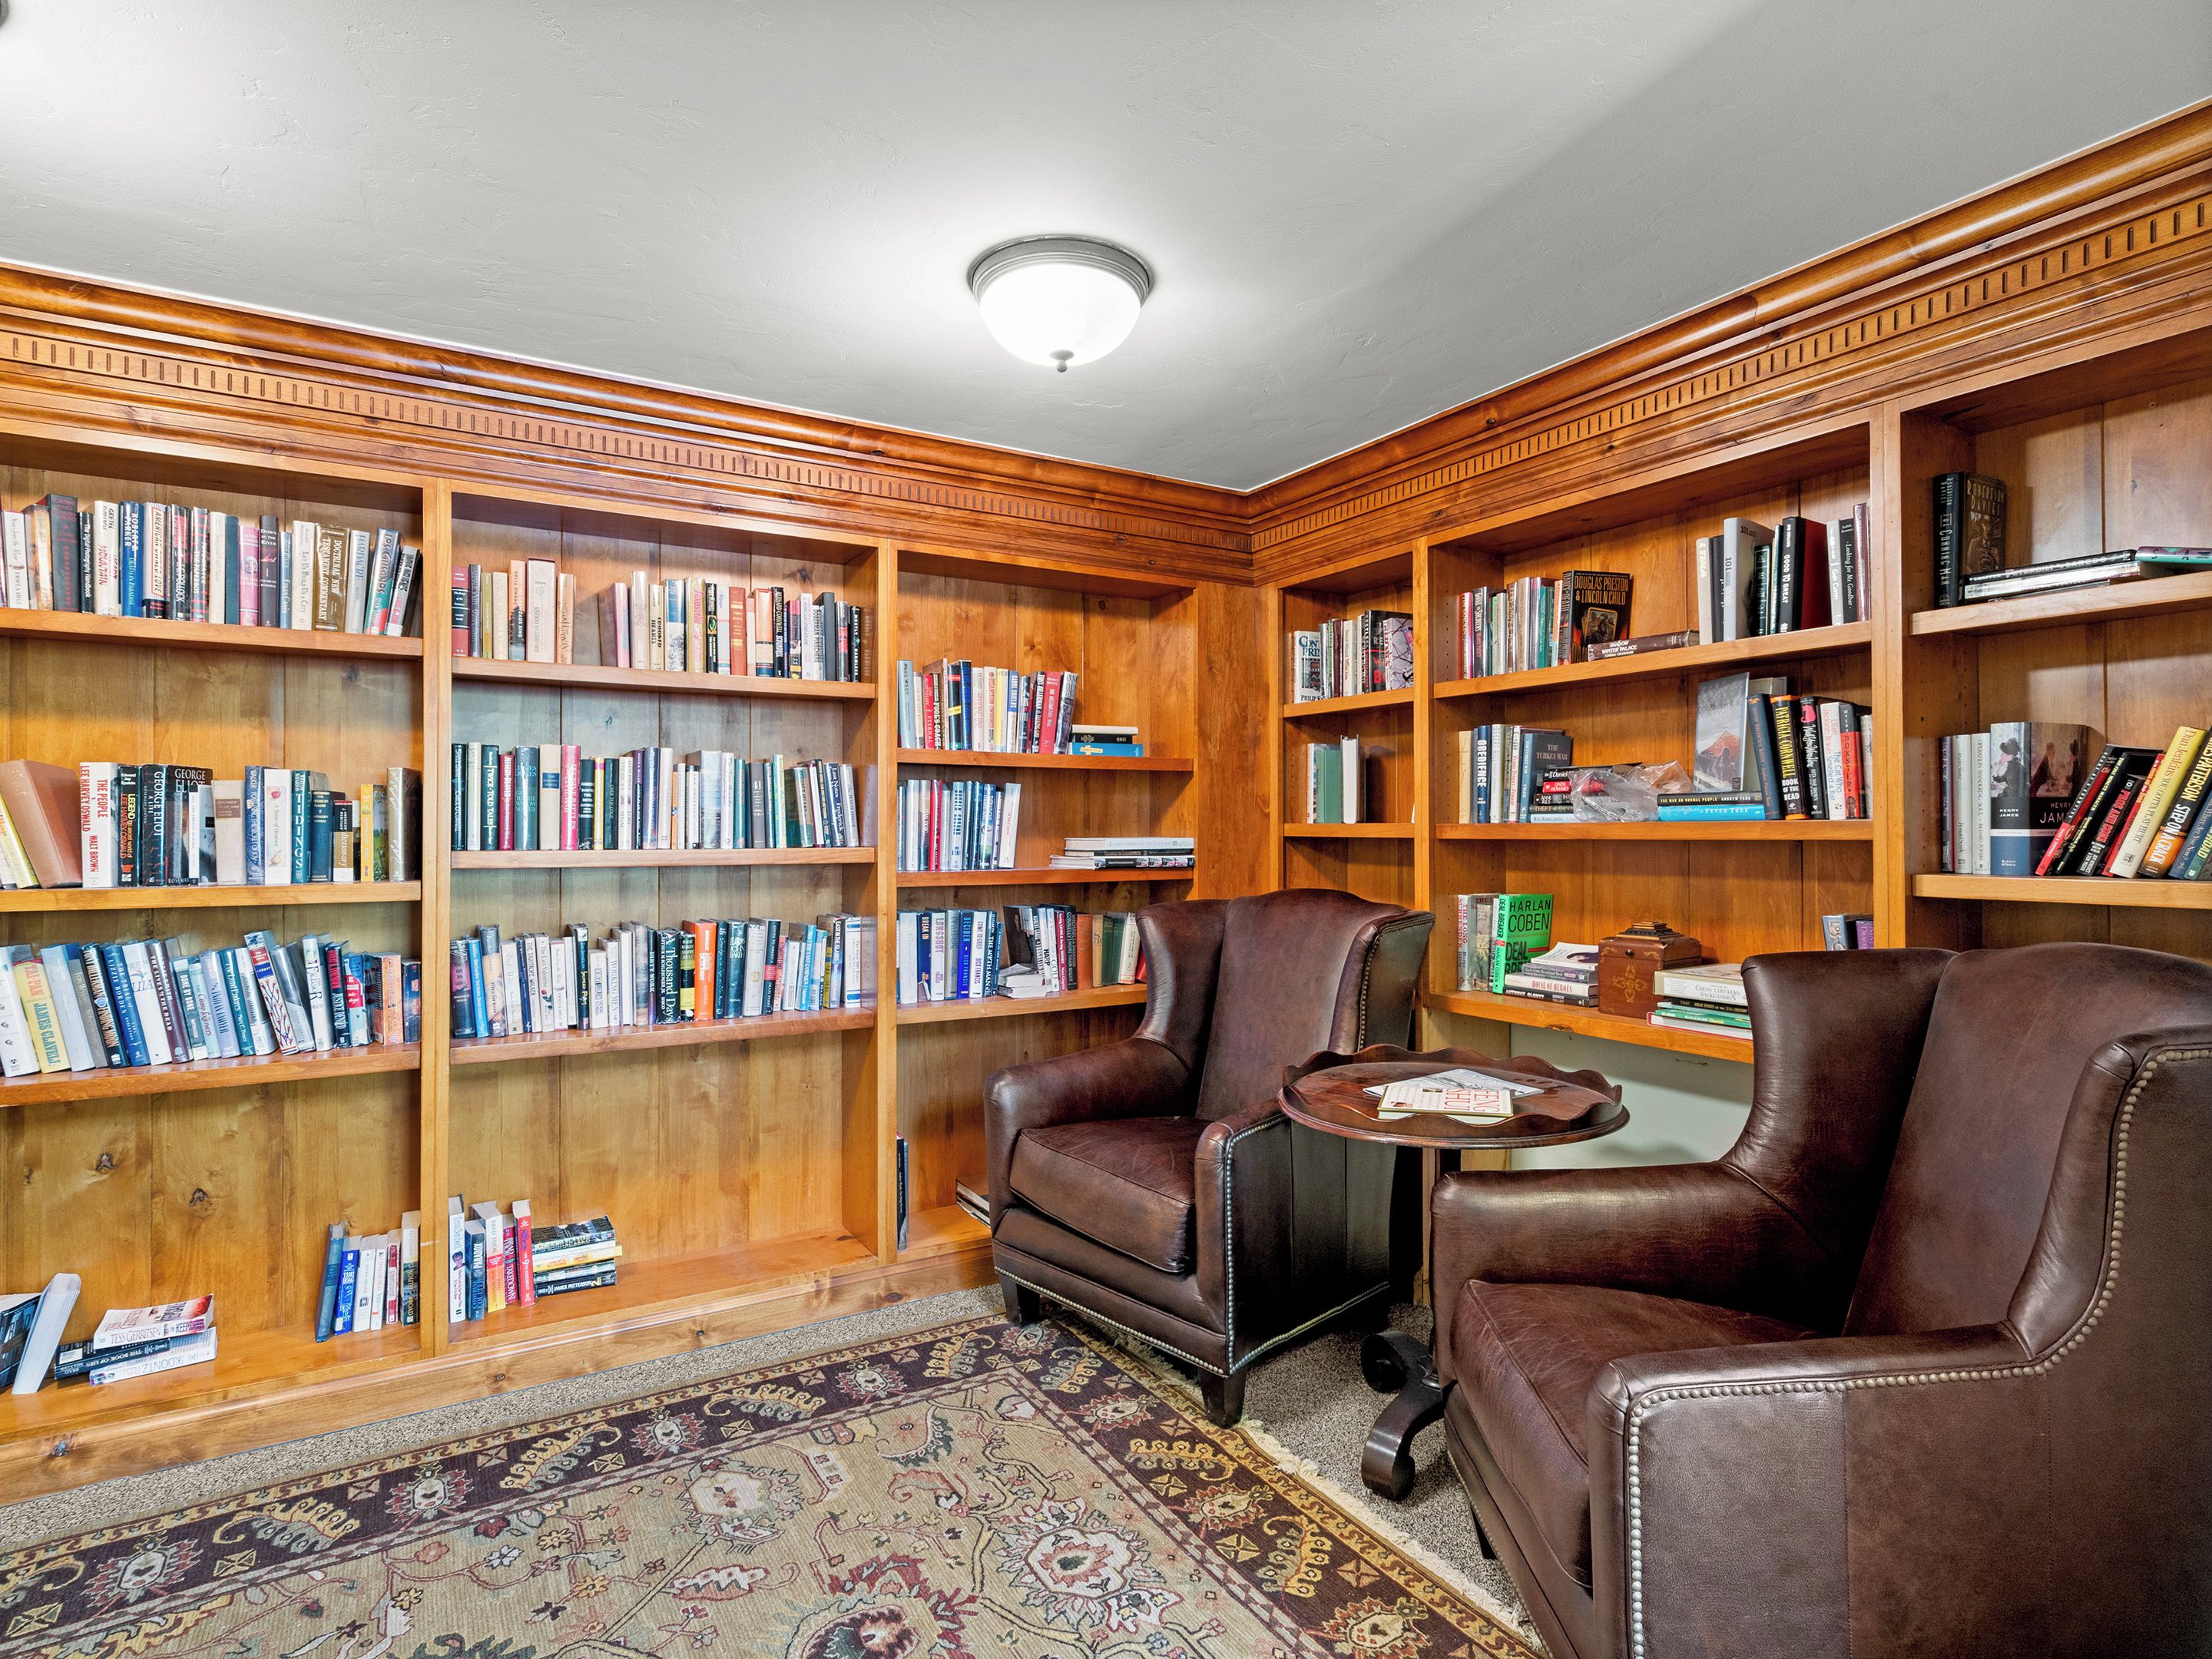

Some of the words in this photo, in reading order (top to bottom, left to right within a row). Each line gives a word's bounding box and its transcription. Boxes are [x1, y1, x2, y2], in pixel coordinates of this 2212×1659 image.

[1967, 479, 2005, 504] ROBERTSON
[1971, 497, 2001, 516] DAVIES
[384, 534, 392, 548] LOS
[1940, 529, 1952, 565] CUNNING
[98, 545, 108, 586] MOUNTAIN
[322, 537, 331, 575] TESTAMENT
[332, 540, 342, 575] DOCTRINAL
[1844, 544, 1853, 565] Looking
[331, 579, 339, 594] NEW
[1574, 576, 1603, 591] DOUGLAS
[1603, 577, 1628, 592] PRESTON
[1783, 574, 1791, 582] TO
[1940, 565, 1951, 585] MAN
[319, 577, 329, 620] COMMENTARY
[694, 590, 704, 624] Texasville
[1575, 591, 1581, 601] &
[1581, 590, 1608, 604] LINCOLN
[1608, 591, 1625, 605] CHILD
[1776, 707, 1789, 738] PATRICIA
[2184, 730, 2197, 745] Dan
[1477, 740, 1487, 787] OBEDIENCE
[1780, 740, 1796, 778] CORNWELL
[2169, 745, 2187, 777] Jenkins
[81, 766, 90, 777] LEE
[175, 768, 205, 780] GEORGE
[1553, 770, 1568, 778] Daniel
[2181, 758, 2211, 801] PATTERSON
[81, 779, 90, 804] HARVEY
[98, 780, 108, 792] THE
[154, 771, 164, 809] GEORGE
[98, 793, 108, 818] PEOPLE
[2170, 803, 2190, 823] STEP
[82, 806, 91, 832] OSWALD
[154, 812, 164, 836] ELIOT
[2164, 820, 2182, 836] ON
[90, 835, 98, 849] WALT
[2134, 823, 2149, 843] HURT
[90, 851, 98, 872] BROWN
[338, 833, 349, 867] dictionary
[2149, 840, 2172, 866] CRACK
[1510, 899, 1551, 912] HARLAN
[1496, 912, 1505, 938] BREAKER
[1508, 912, 1550, 933] COBEN
[666, 936, 673, 945] A
[935, 918, 944, 953] LONGSHOT
[1505, 940, 1528, 962] DEAL
[666, 948, 677, 995] Thousand
[108, 959, 118, 983] LIZZIE
[115, 986, 127, 1015] BORDEN
[121, 979, 130, 1001] TRIAL
[1532, 981, 1546, 989] HOUSE
[1554, 983, 1573, 992] HEROES
[34, 1002, 52, 1030] JAMES
[98, 1007, 116, 1031] FINDING
[664, 998, 675, 1022] Days
[105, 1031, 119, 1048] MOON
[474, 1243, 483, 1268] PARADOX
[506, 1264, 515, 1300] TAKEDOWN
[111, 1333, 127, 1344] TESS
[110, 1353, 128, 1361] BOOK
[143, 1357, 181, 1373] KOONTZ
